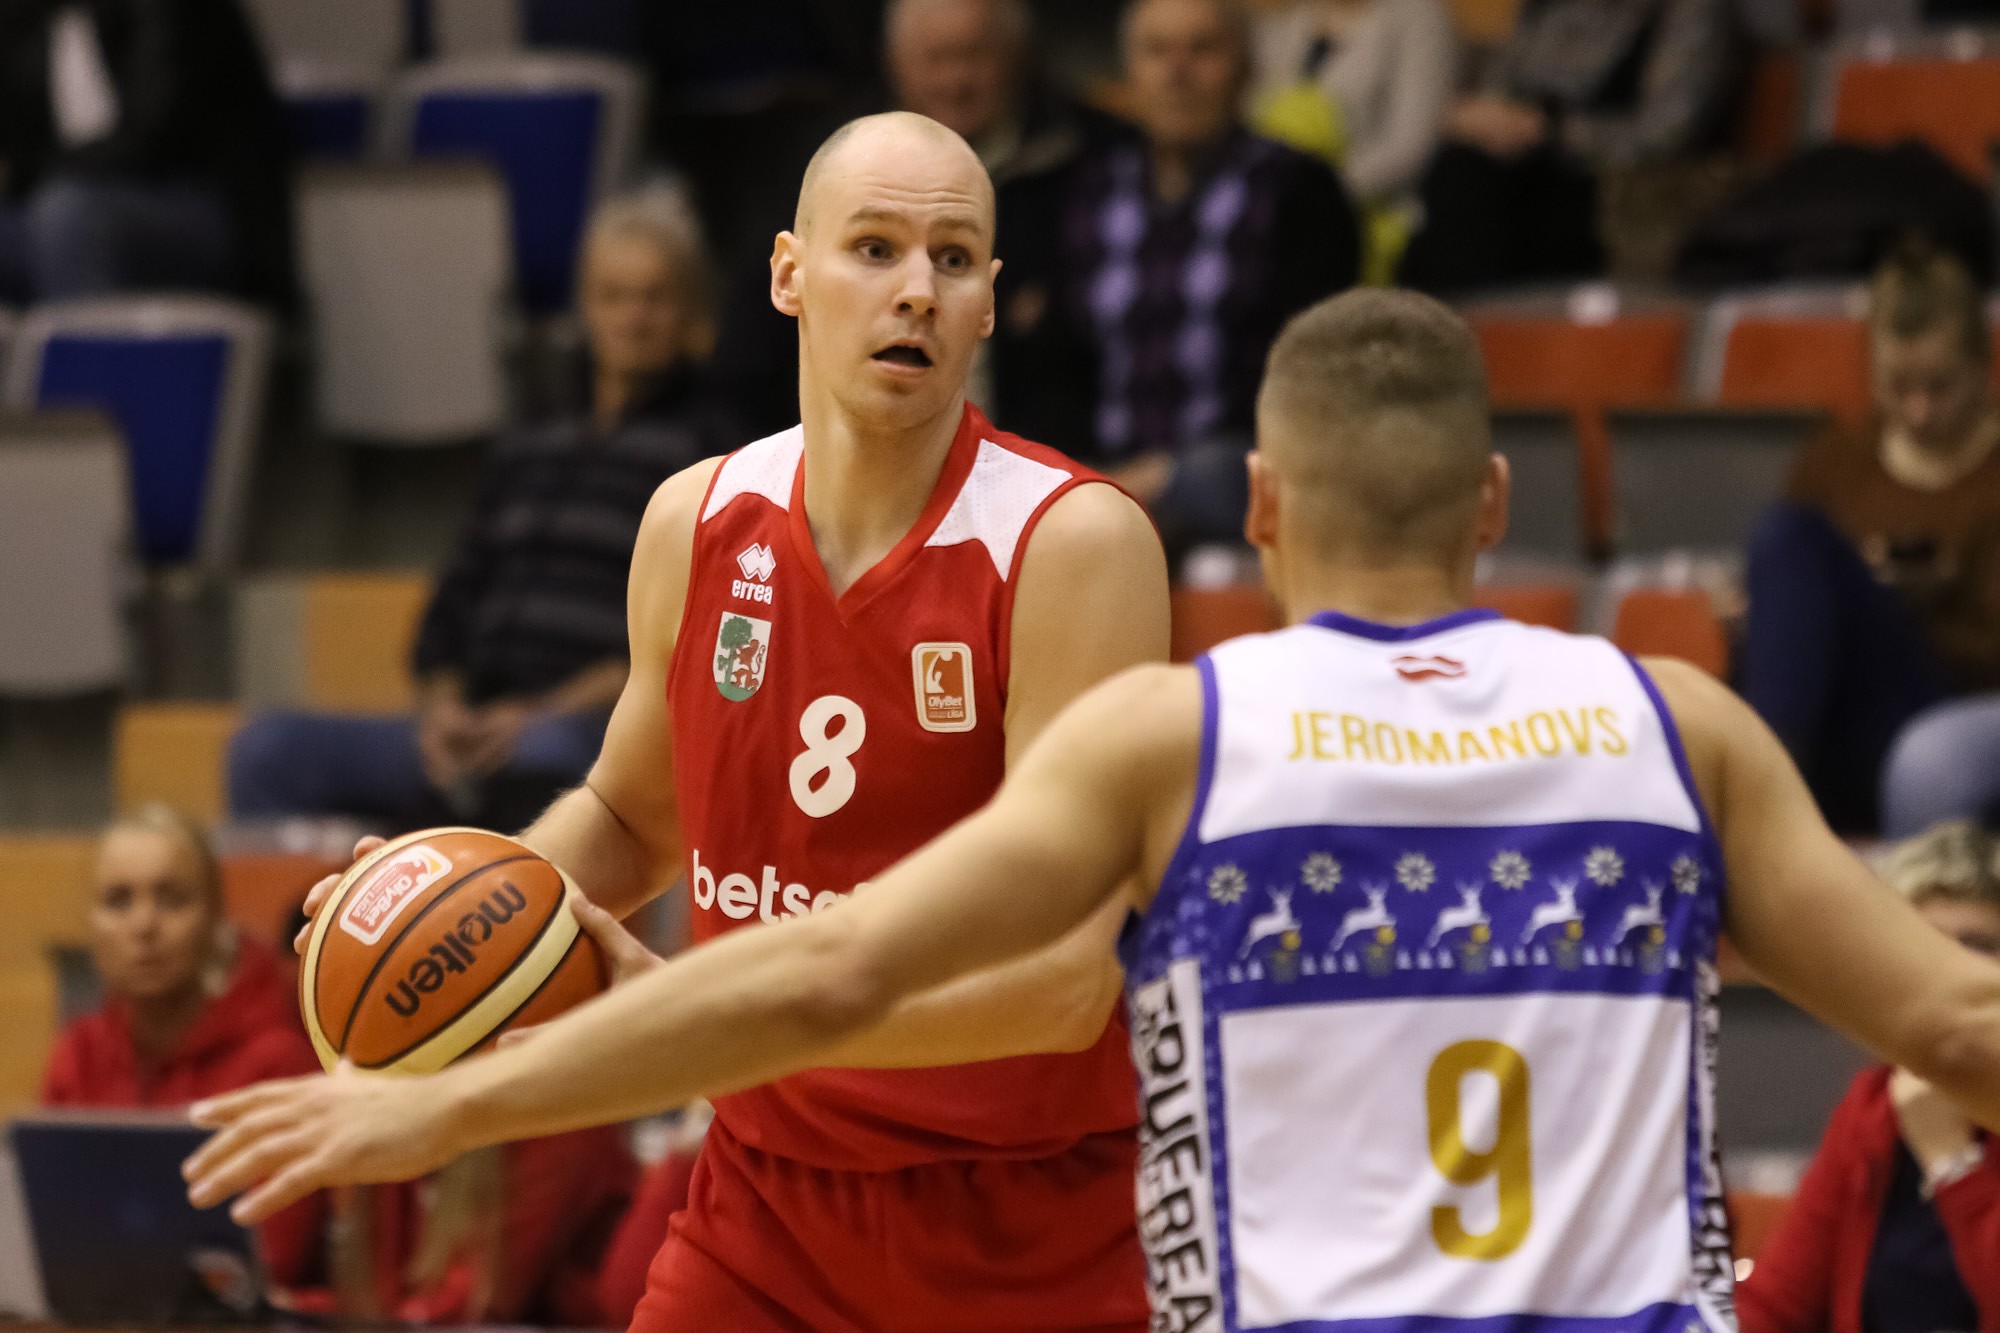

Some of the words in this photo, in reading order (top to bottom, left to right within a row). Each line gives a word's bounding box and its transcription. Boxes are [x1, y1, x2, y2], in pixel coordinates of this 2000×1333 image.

[731, 579, 773, 605] errea
[928, 696, 963, 709] OlyBet
[1287, 707, 1628, 765] JEROMANOVS
[789, 695, 866, 818] 8
[363, 875, 413, 927] OlyBet
[693, 849, 872, 925] bets
[384, 880, 527, 1018] molten
[1426, 1039, 1533, 1262] 9
